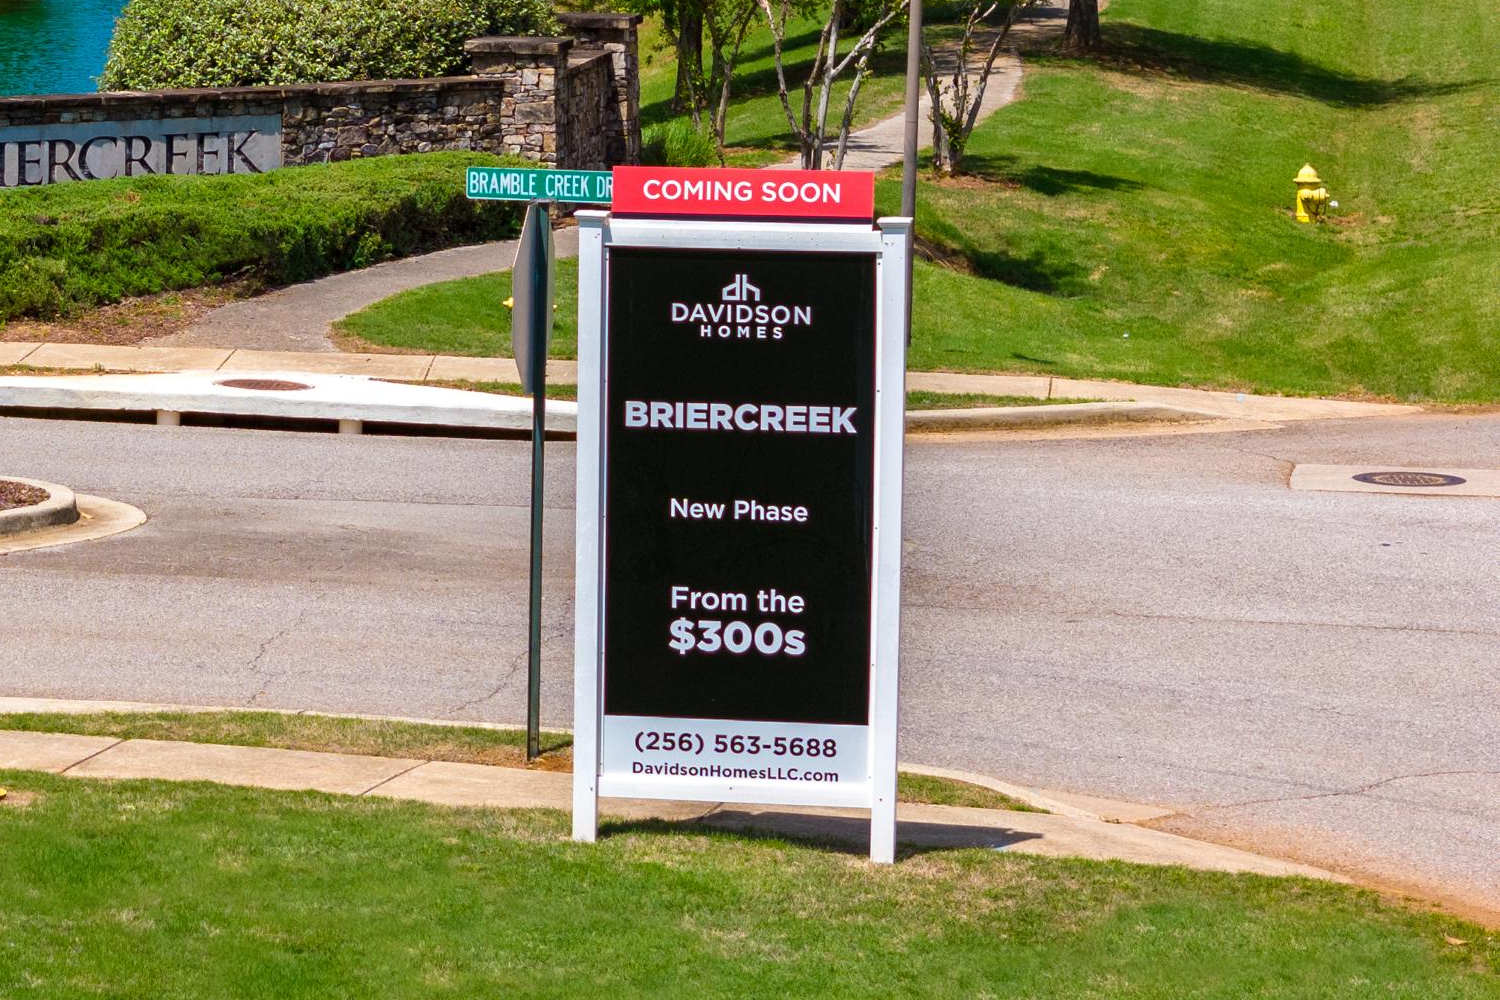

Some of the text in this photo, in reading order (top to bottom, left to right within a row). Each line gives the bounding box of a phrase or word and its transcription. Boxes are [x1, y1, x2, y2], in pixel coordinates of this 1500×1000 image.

[469, 172, 613, 198] BRAMBLE CREEK DR
[643, 180, 841, 203] COMING SOON
[671, 303, 811, 326] DAVIDSON
[700, 325, 783, 340] HOMES
[625, 401, 858, 434] BRIERCREEK
[671, 498, 809, 522] New Phase
[671, 586, 805, 613] From the
[669, 617, 806, 655] $300s
[634, 731, 838, 758] (256) 563-5688
[632, 761, 839, 782] DavidsonHomesLLC.com
